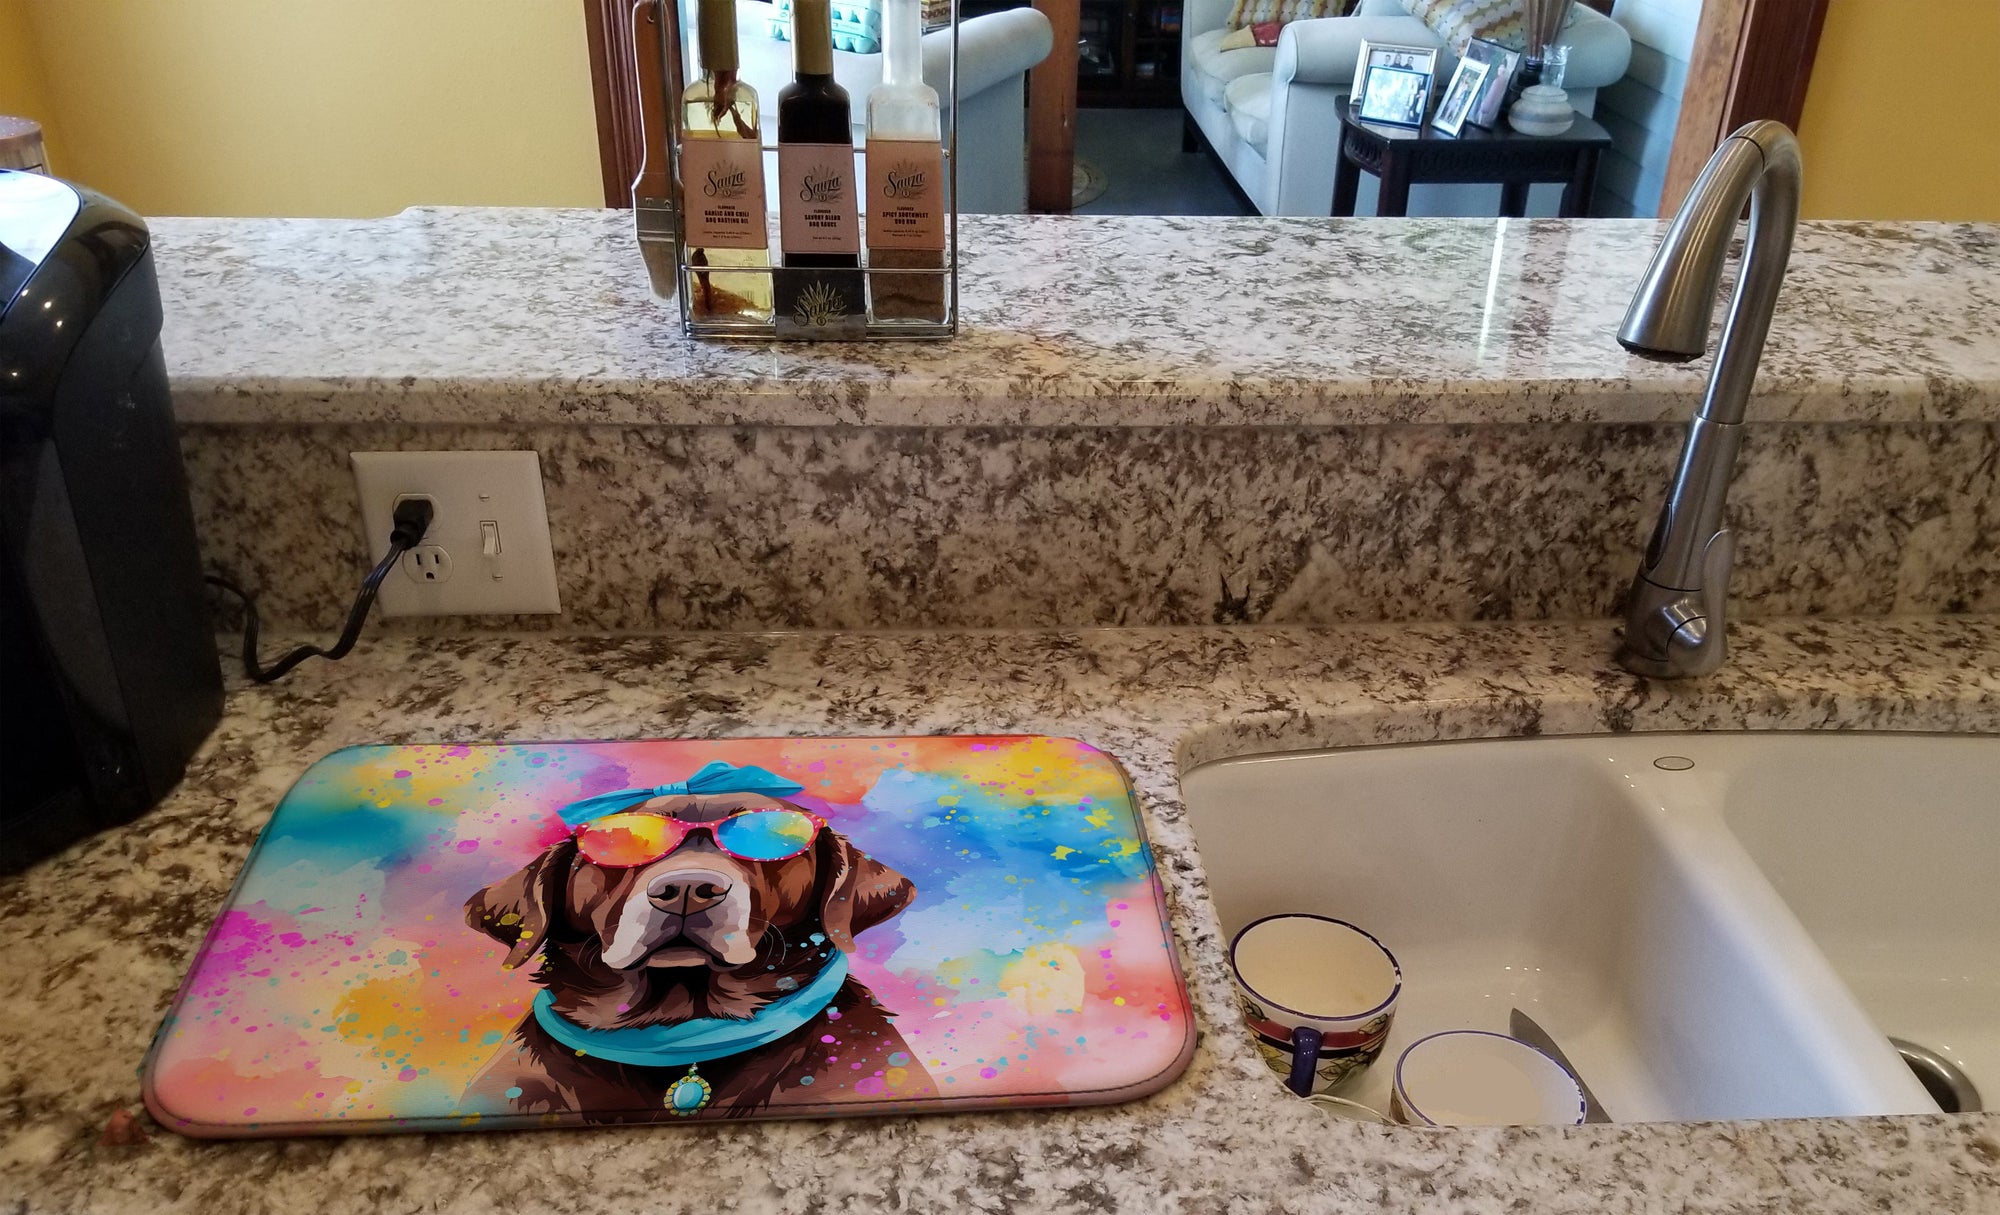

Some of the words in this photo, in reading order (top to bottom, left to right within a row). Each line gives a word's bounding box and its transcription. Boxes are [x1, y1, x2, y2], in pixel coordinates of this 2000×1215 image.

[703, 169, 745, 197] Sauza
[799, 175, 841, 202] Sauza
[883, 169, 925, 198] Sauza
